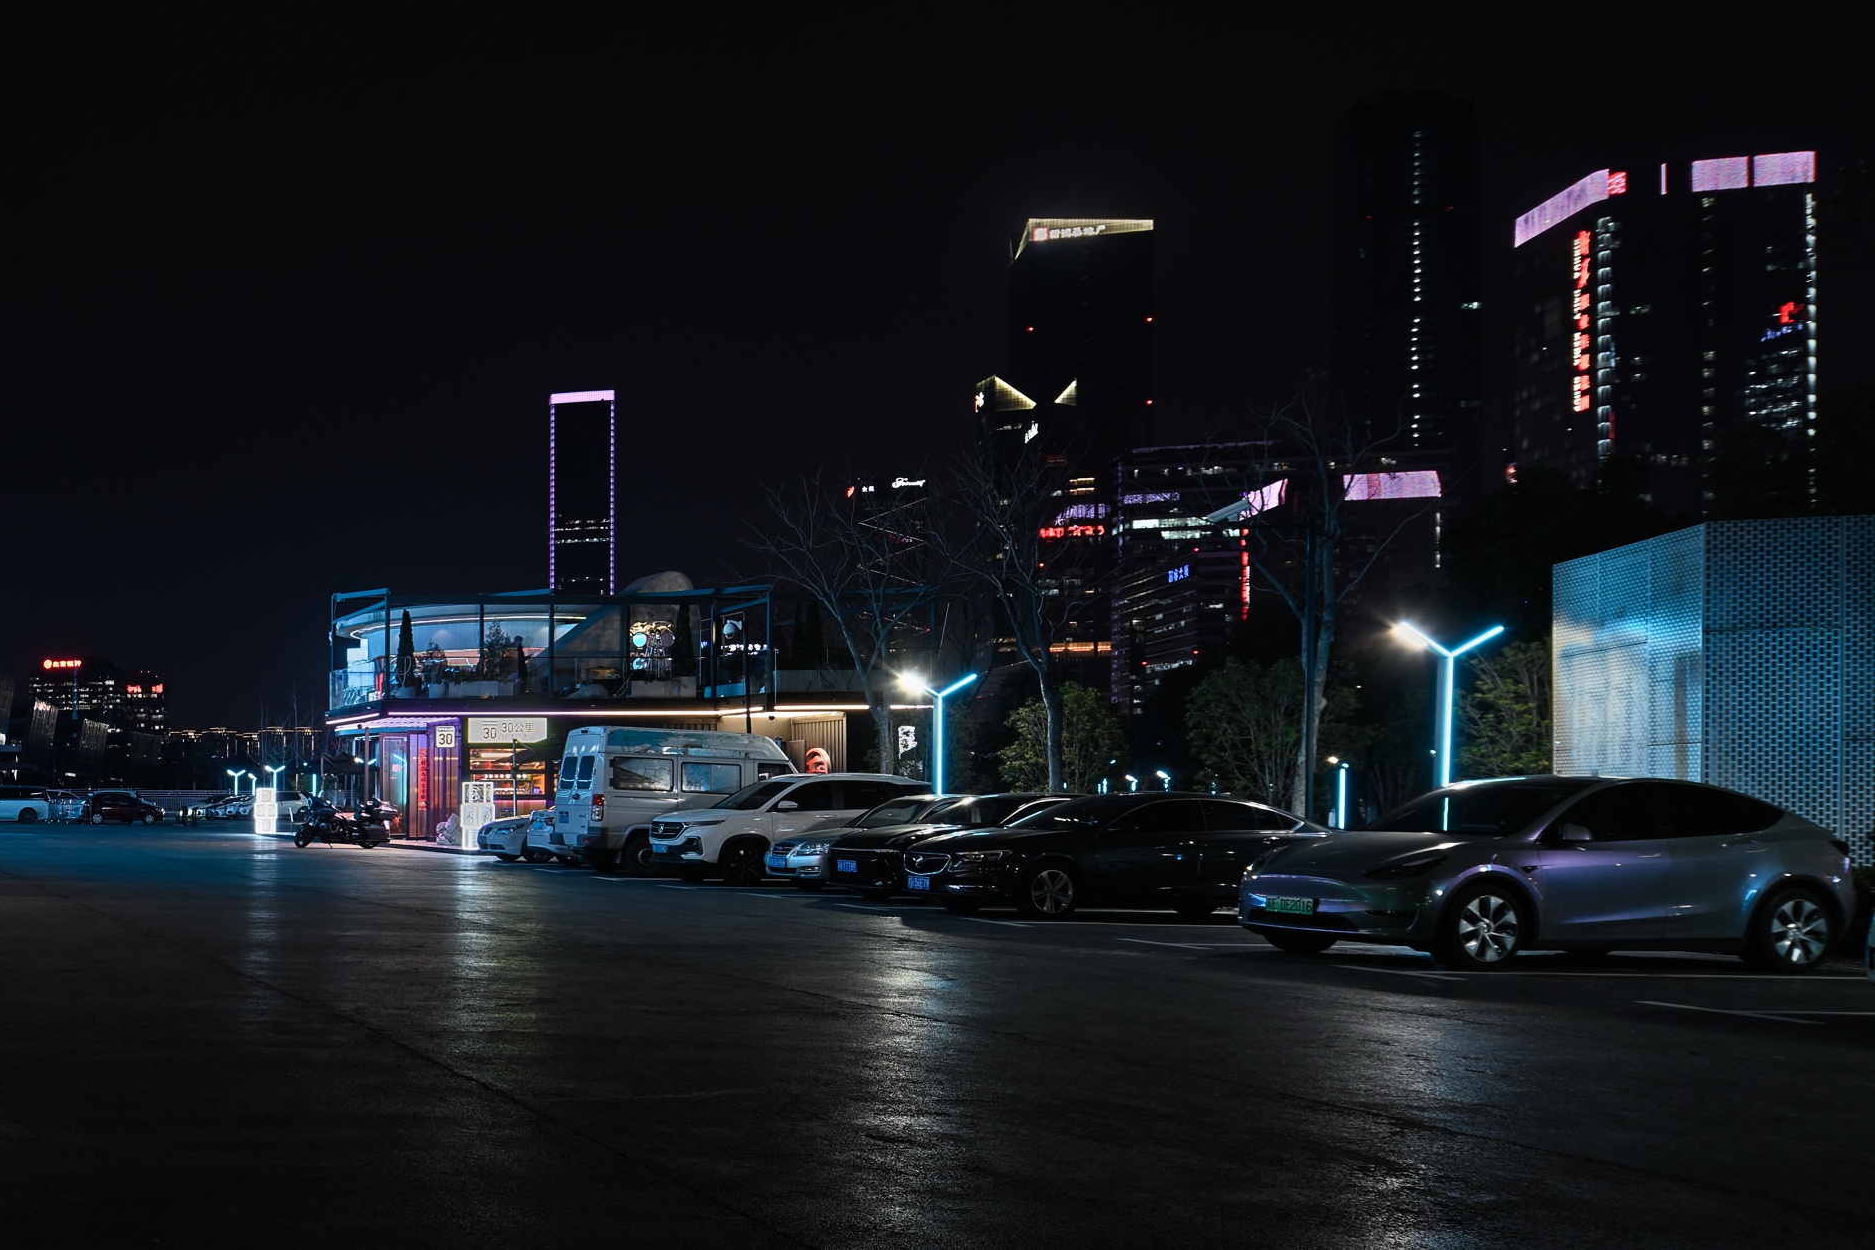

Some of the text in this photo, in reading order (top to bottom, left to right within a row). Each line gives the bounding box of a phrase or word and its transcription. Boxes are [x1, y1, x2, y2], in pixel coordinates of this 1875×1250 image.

[483, 727, 497, 739] 30
[501, 722, 535, 733] 30公里
[439, 733, 453, 745] 30
